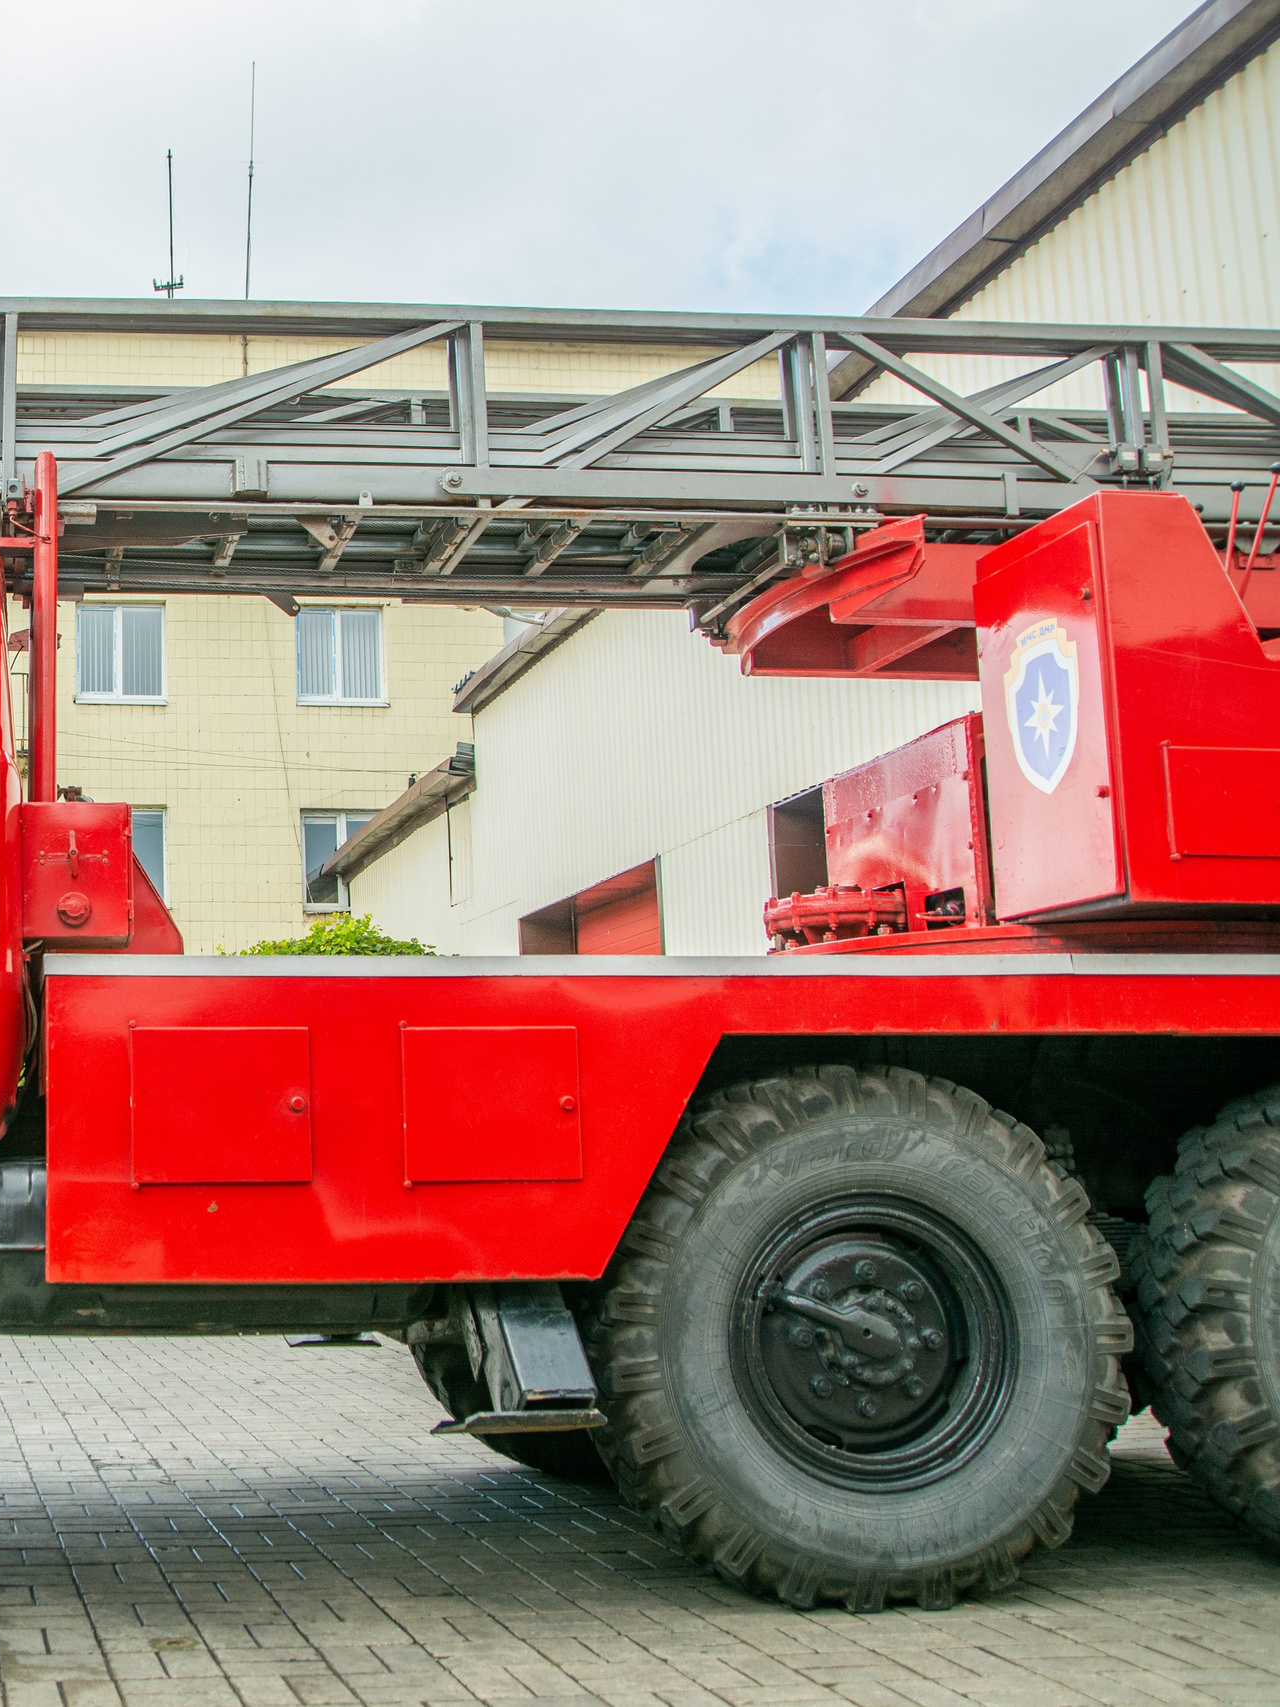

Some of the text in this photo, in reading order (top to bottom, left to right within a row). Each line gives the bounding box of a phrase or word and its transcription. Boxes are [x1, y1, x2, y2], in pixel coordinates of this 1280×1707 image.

[1020, 624, 1055, 647] МЧС ДНР
[915, 1139, 1072, 1308] Traction
